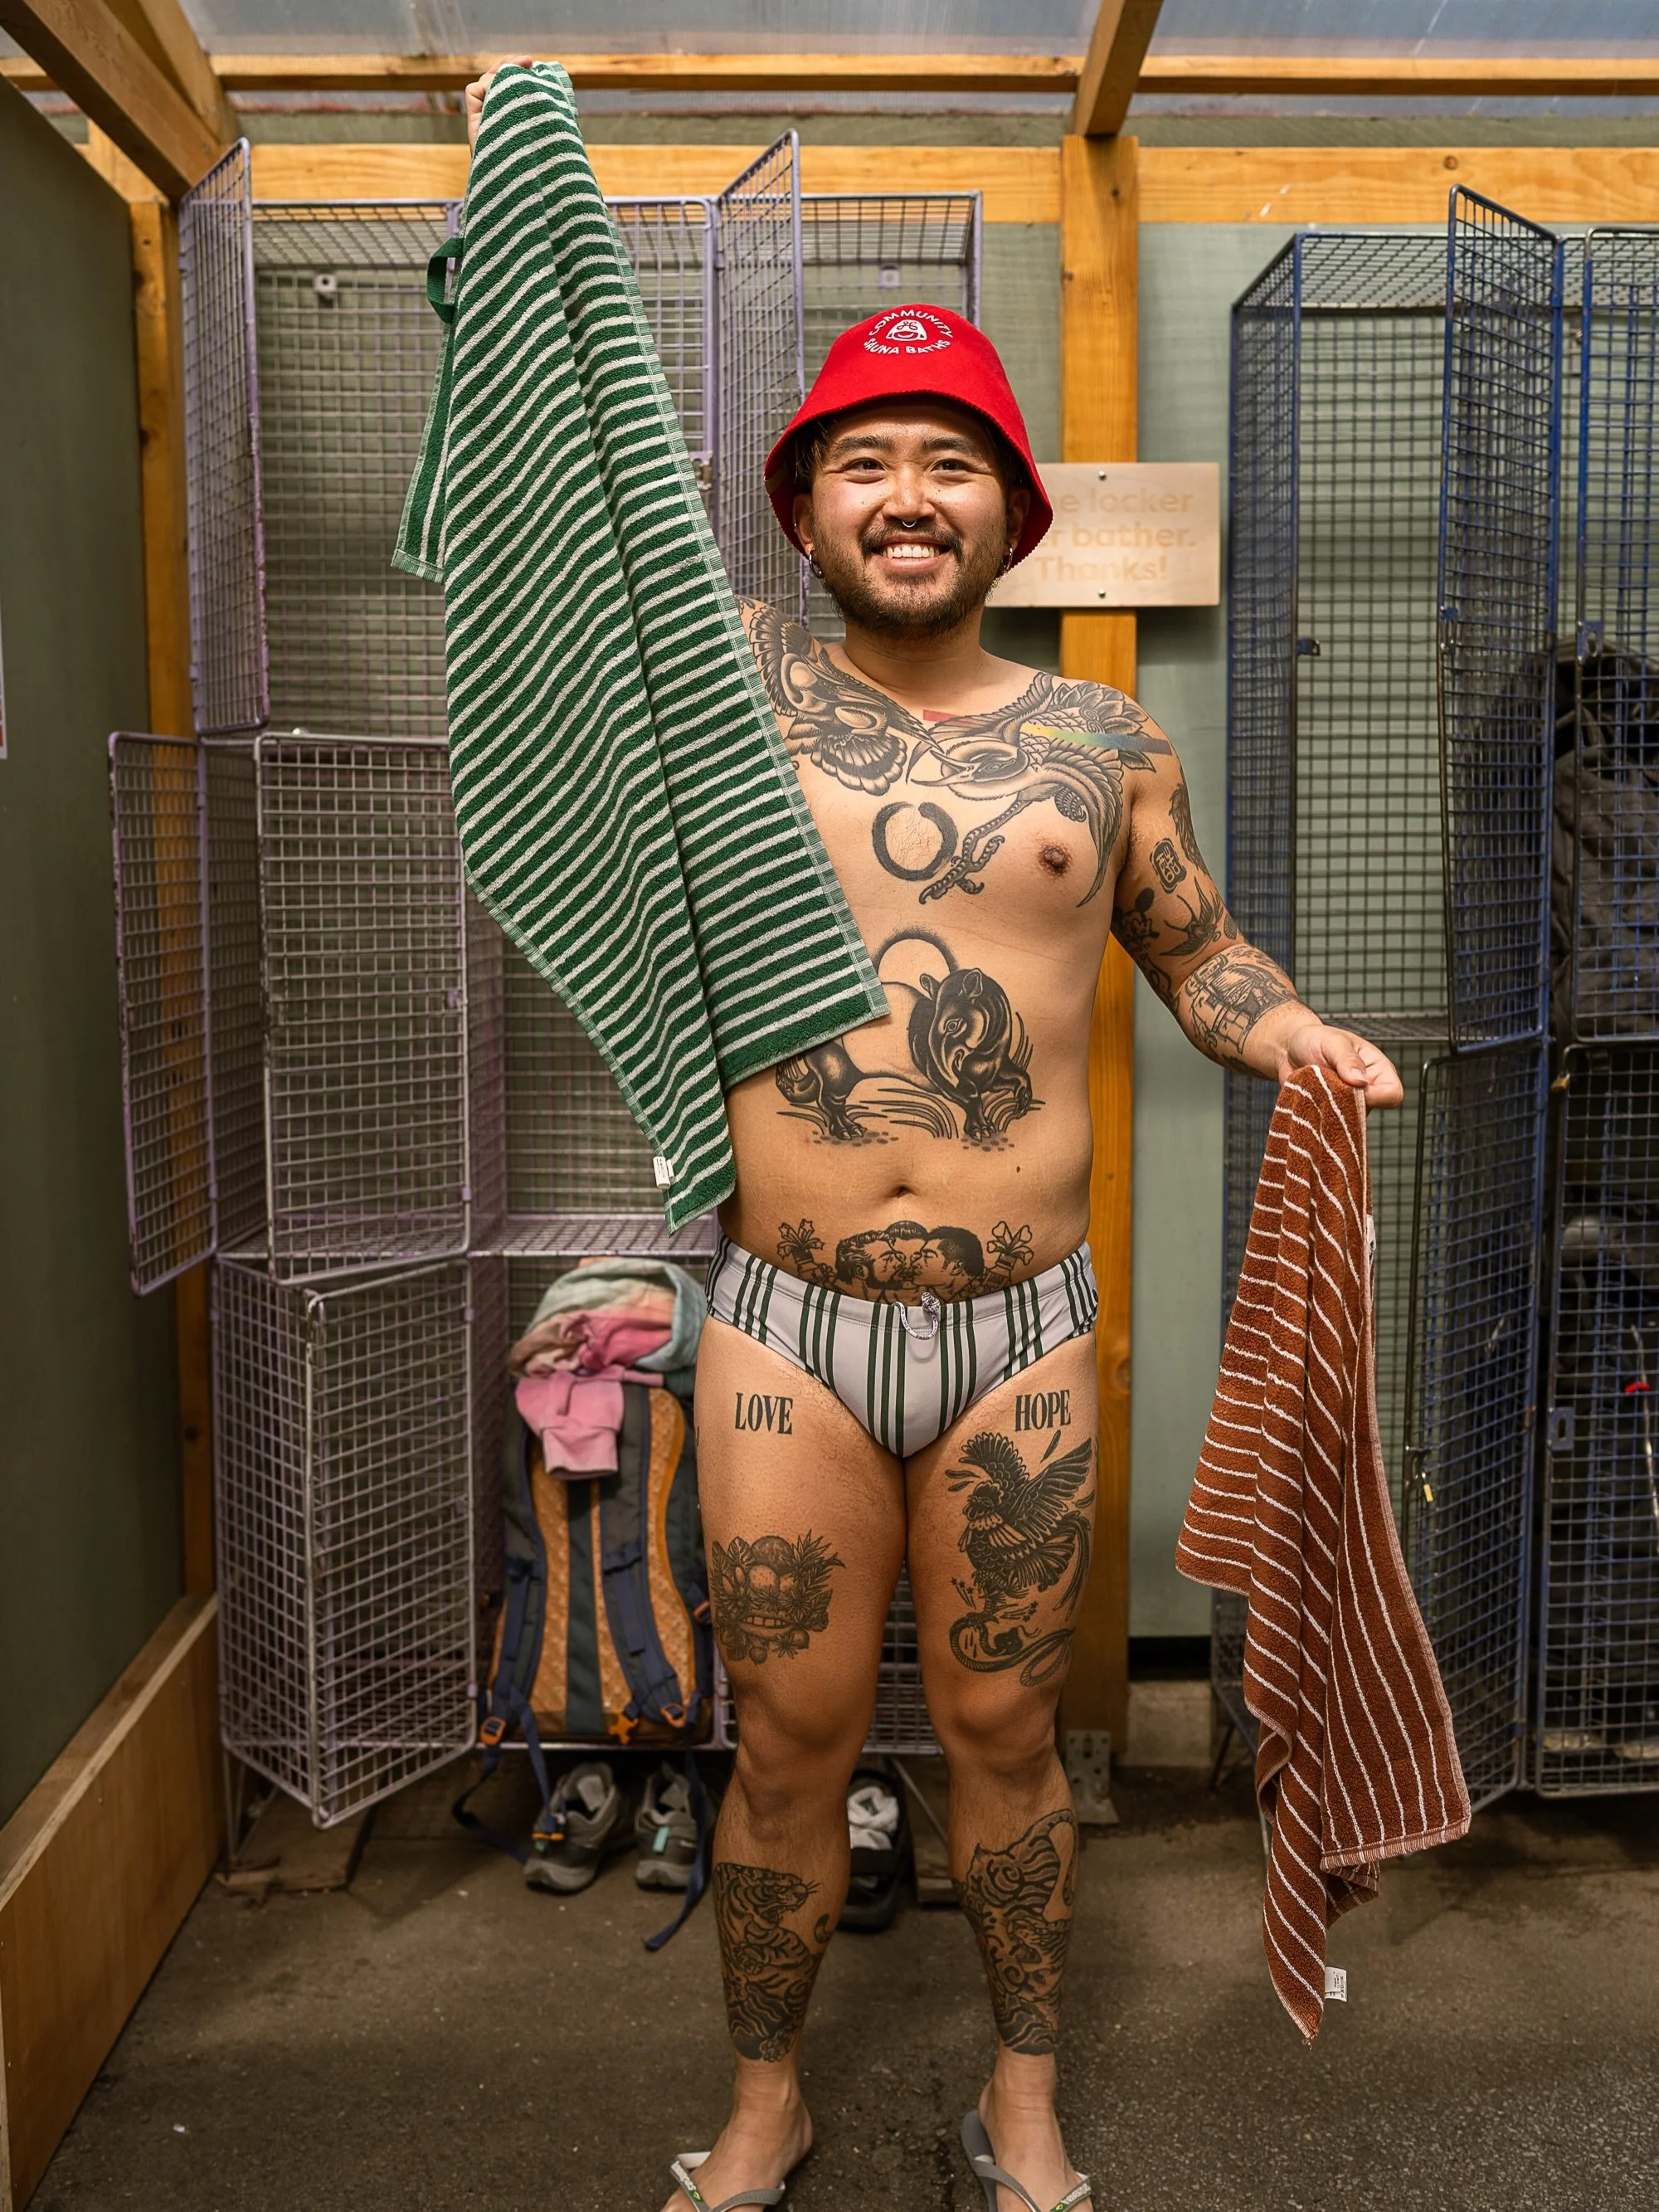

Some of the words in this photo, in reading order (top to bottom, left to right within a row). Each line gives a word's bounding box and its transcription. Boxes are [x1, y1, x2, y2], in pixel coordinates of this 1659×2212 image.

[868, 309, 953, 339] COMMUNITY
[864, 338, 900, 354] SAUNA
[906, 339, 951, 354] BATHS
[1088, 486, 1194, 514] locker
[1072, 520, 1197, 548] bather.
[1034, 555, 1167, 582] Thanks!
[735, 1391, 794, 1435] LOVE
[1014, 1389, 1071, 1432] HOPE
